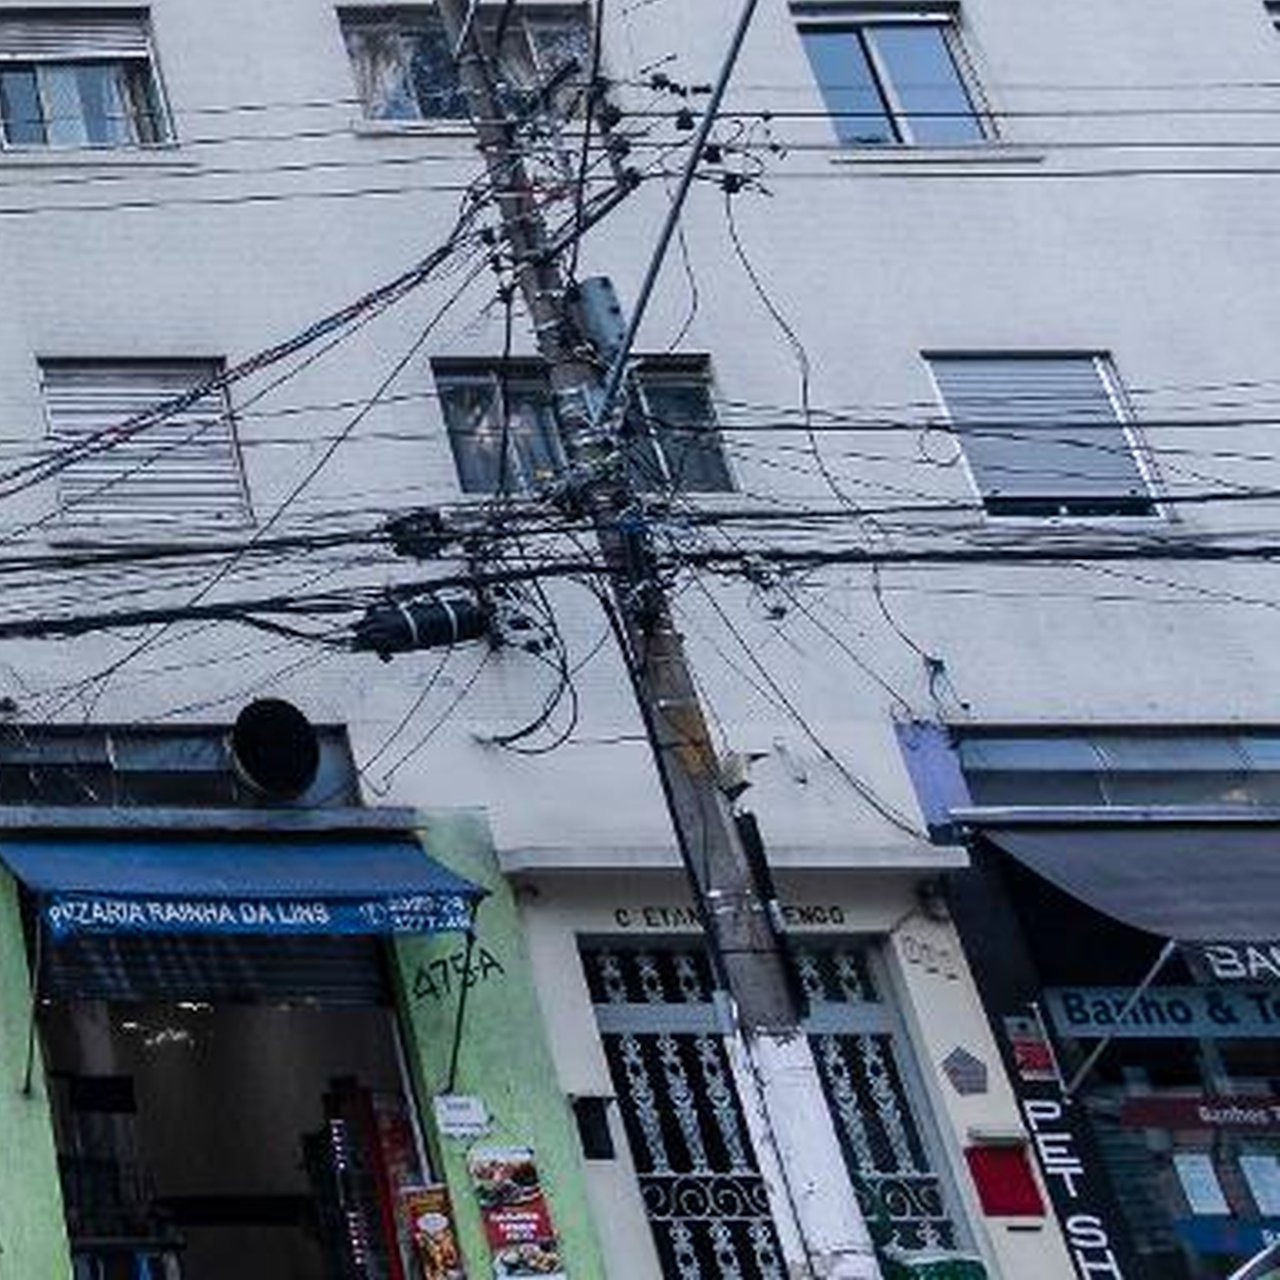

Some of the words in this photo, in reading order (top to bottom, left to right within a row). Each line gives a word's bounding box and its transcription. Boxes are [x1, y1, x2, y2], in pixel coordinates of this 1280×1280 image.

[239, 902, 275, 925] DA
[1204, 945, 1280, 978] BA
[1062, 993, 1195, 1025] Banho
[1207, 991, 1241, 1025] &
[1023, 1100, 1085, 1198] PET
